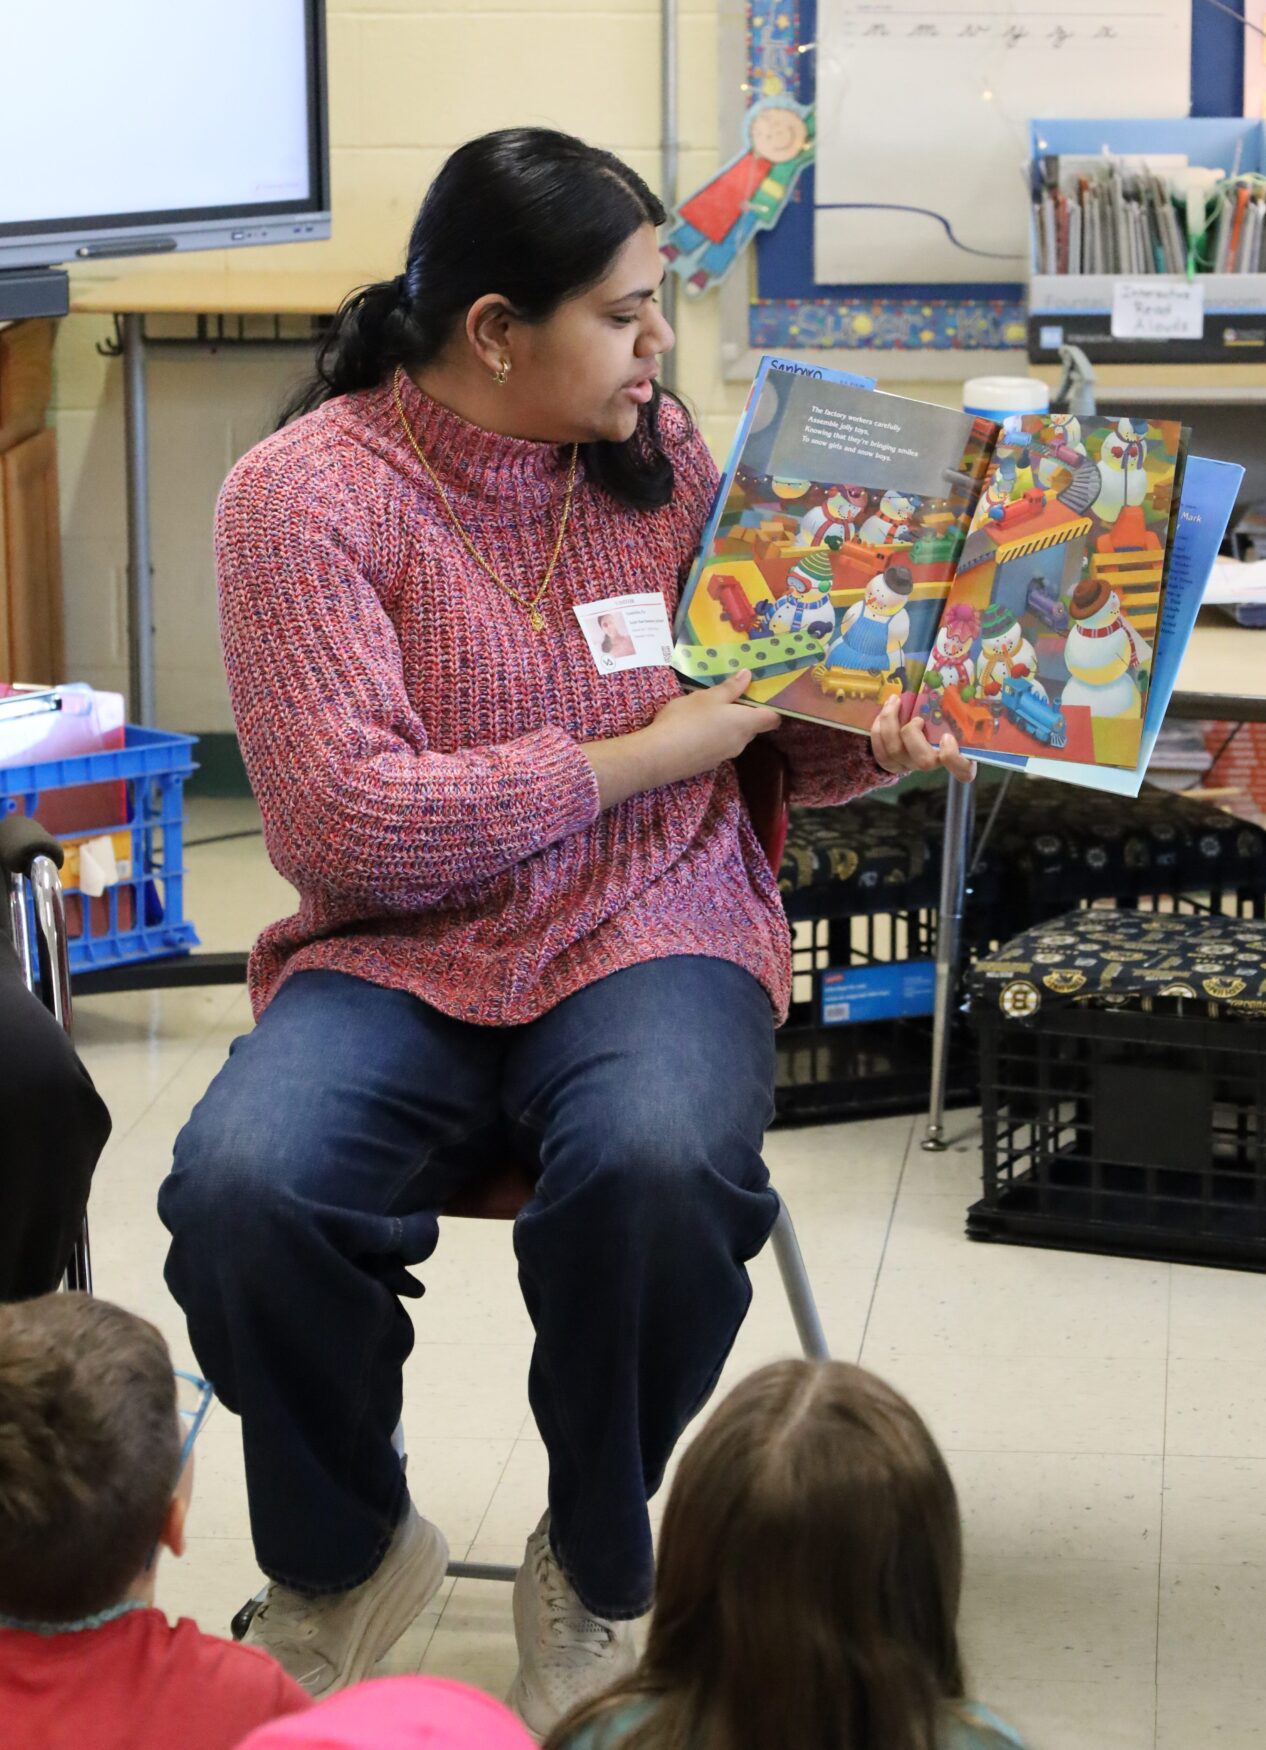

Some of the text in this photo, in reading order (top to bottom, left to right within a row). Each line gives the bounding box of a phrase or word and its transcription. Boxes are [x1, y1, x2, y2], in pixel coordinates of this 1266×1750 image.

[808, 416, 839, 428] Assemble
[839, 423, 853, 432] jolly
[812, 405, 901, 432] The factory workers carefully
[804, 425, 919, 457] Knowing that they're bringing smiles
[811, 438, 828, 446] snow
[828, 442, 843, 450] girls
[857, 449, 874, 457] snow
[1181, 511, 1202, 523] Mark
